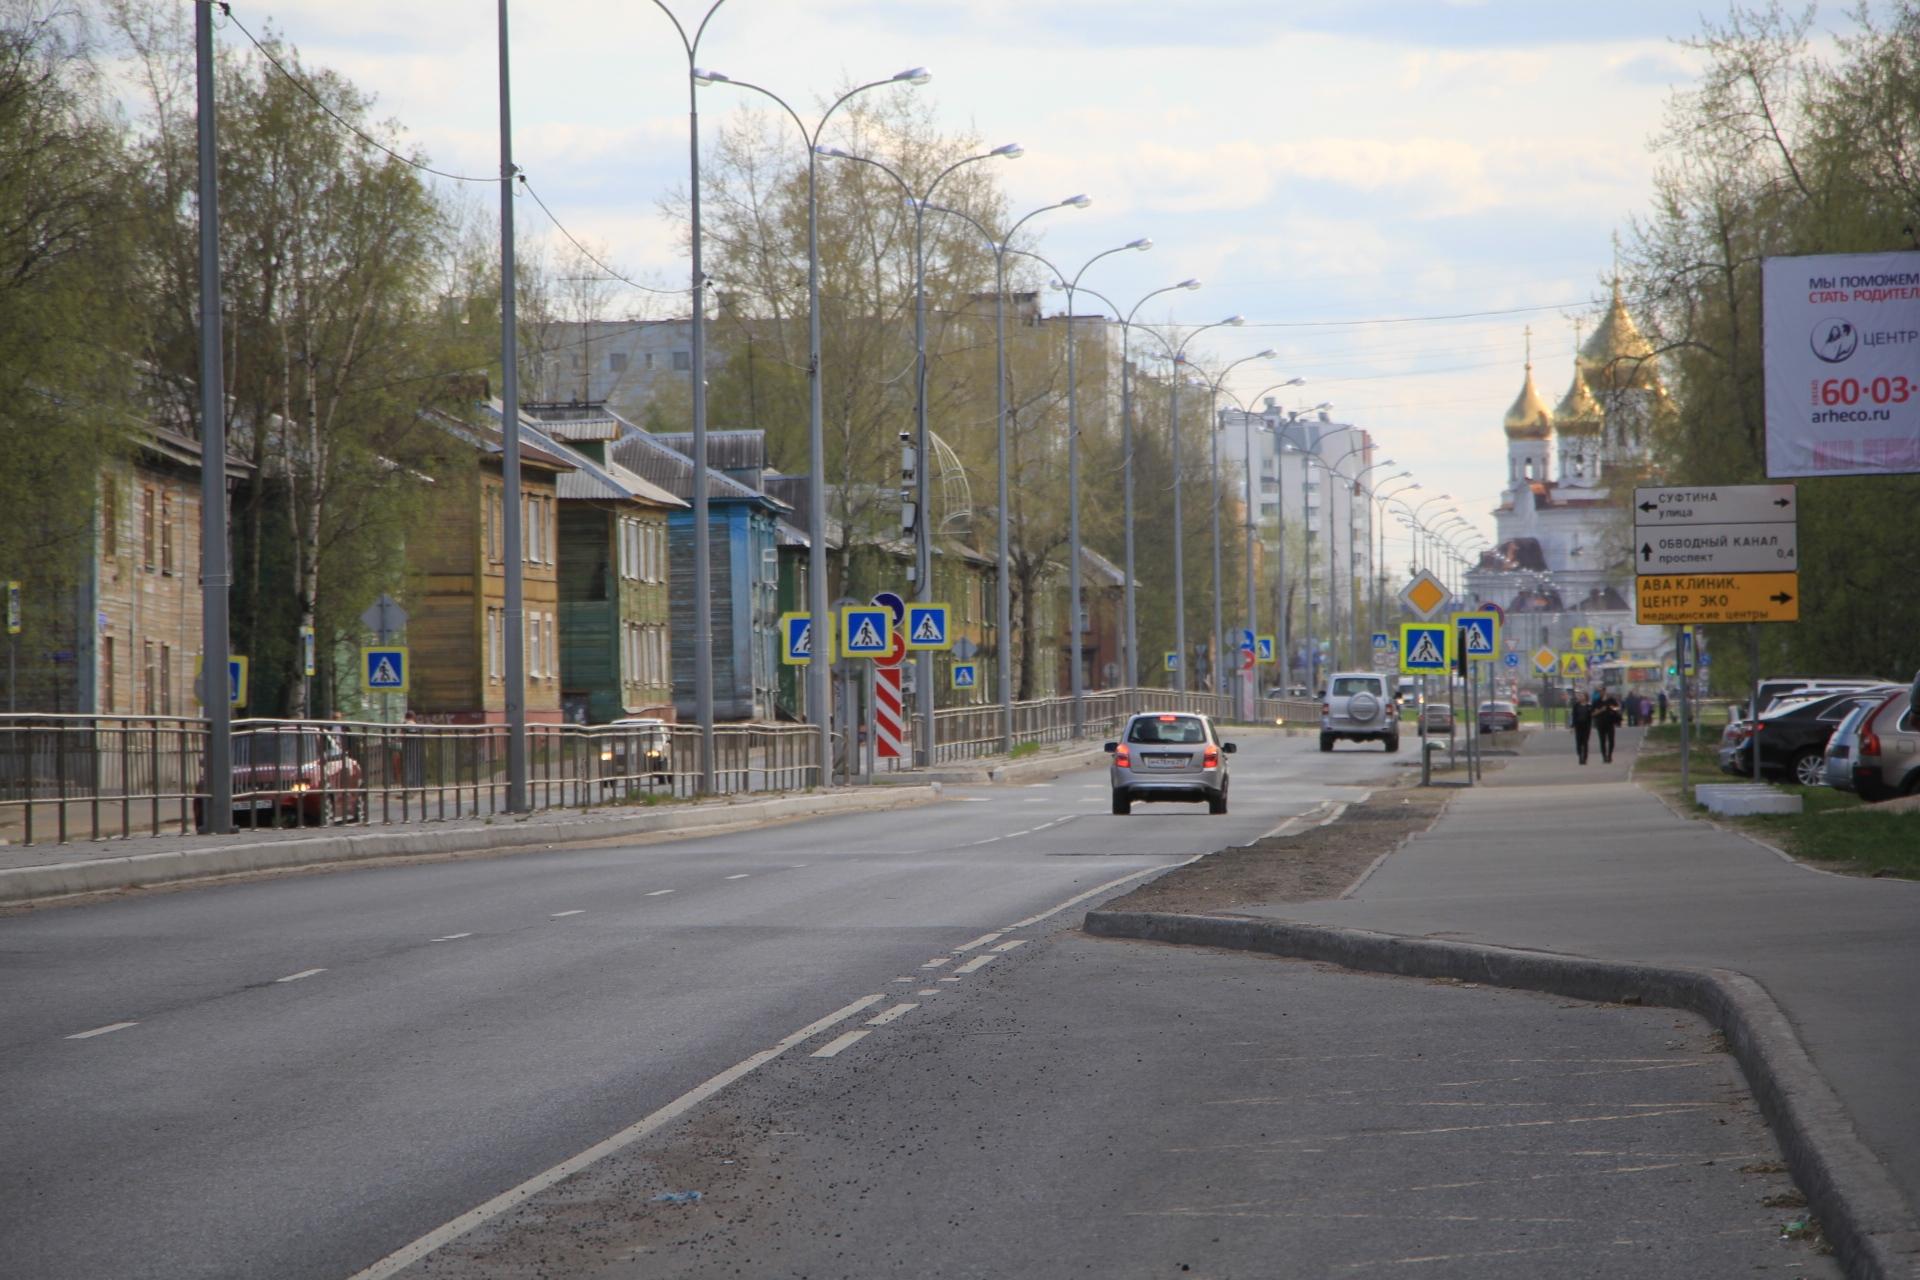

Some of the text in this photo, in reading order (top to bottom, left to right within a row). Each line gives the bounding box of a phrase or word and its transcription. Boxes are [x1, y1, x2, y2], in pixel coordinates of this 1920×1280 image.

[1809, 273, 1919, 289] МЫ ПОМОЖЕМ
[1809, 290, 1849, 303] СТАТЬ
[1864, 331, 1919, 348] ЦЕНТР
[1812, 409, 1890, 424] arheco.ru
[1658, 492, 1718, 504] СУФТИНА
[1659, 509, 1693, 520] улица
[1659, 536, 1778, 549] ОБВОДНЫЙ КАНАЛ
[1659, 554, 1713, 565] проспект
[1777, 548, 1795, 560] 0,4
[1643, 579, 1672, 590] АВА
[1642, 595, 1729, 608] ЦЕНТР ЭКО
[1643, 609, 1769, 621] медицинские центры
